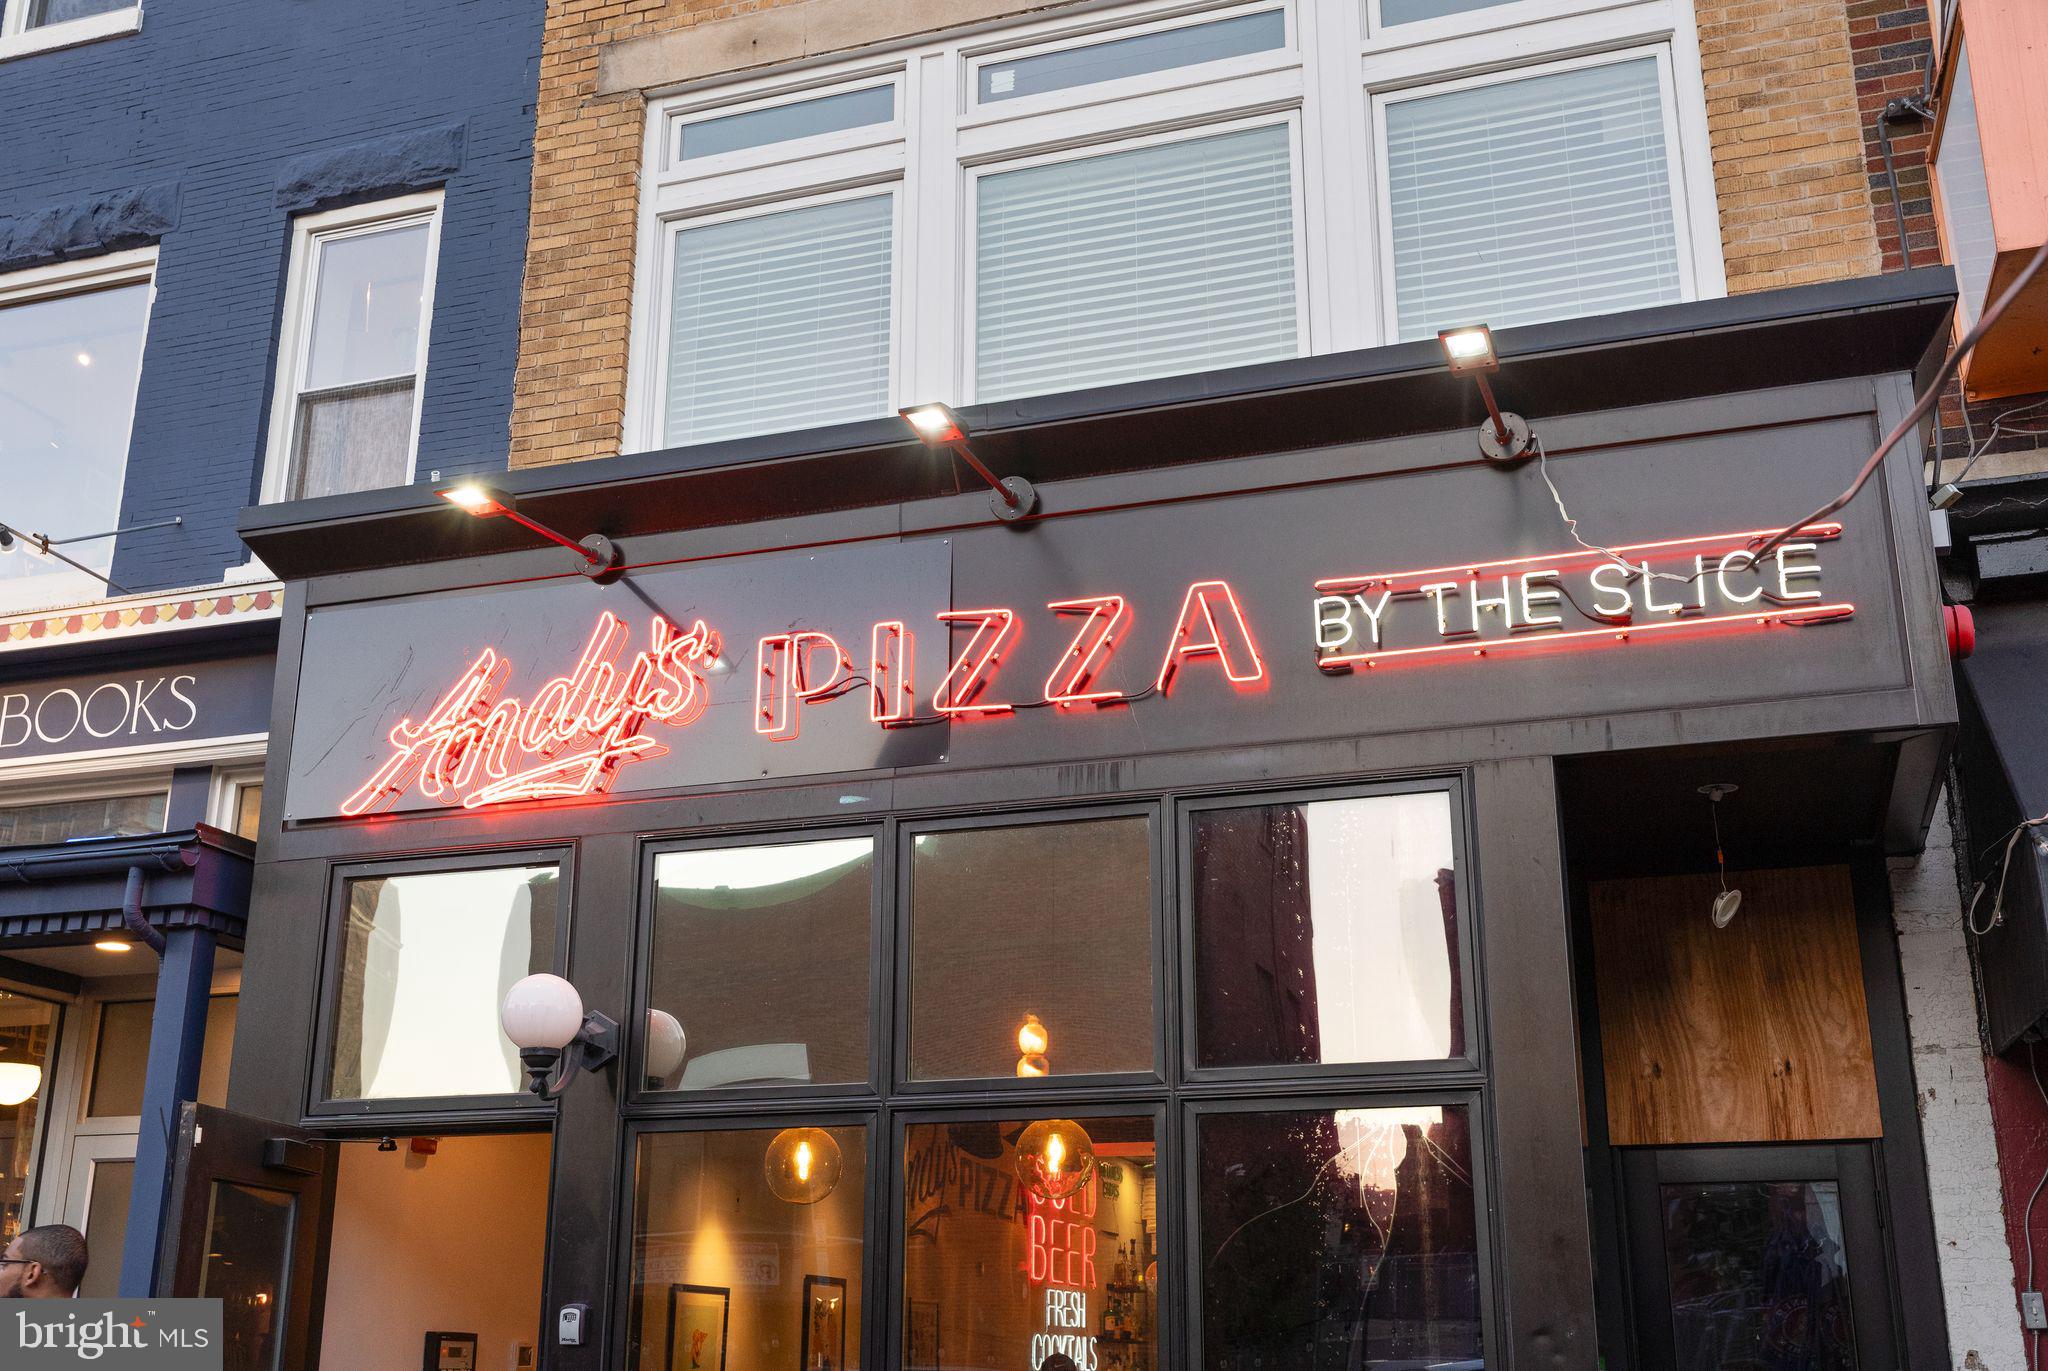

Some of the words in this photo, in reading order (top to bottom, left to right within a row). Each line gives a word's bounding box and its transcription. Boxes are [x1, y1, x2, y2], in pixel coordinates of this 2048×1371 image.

[0, 675, 197, 748] BOOKS
[340, 610, 708, 816] Andy's
[754, 580, 1263, 733] PIZZA
[1314, 590, 1392, 648] BY
[1419, 569, 1563, 636] THE
[1588, 542, 1823, 617] SLICE
[959, 1156, 1029, 1228] PIZZA
[1030, 1214, 1097, 1289] BEER
[1046, 1288, 1086, 1328] FRESH
